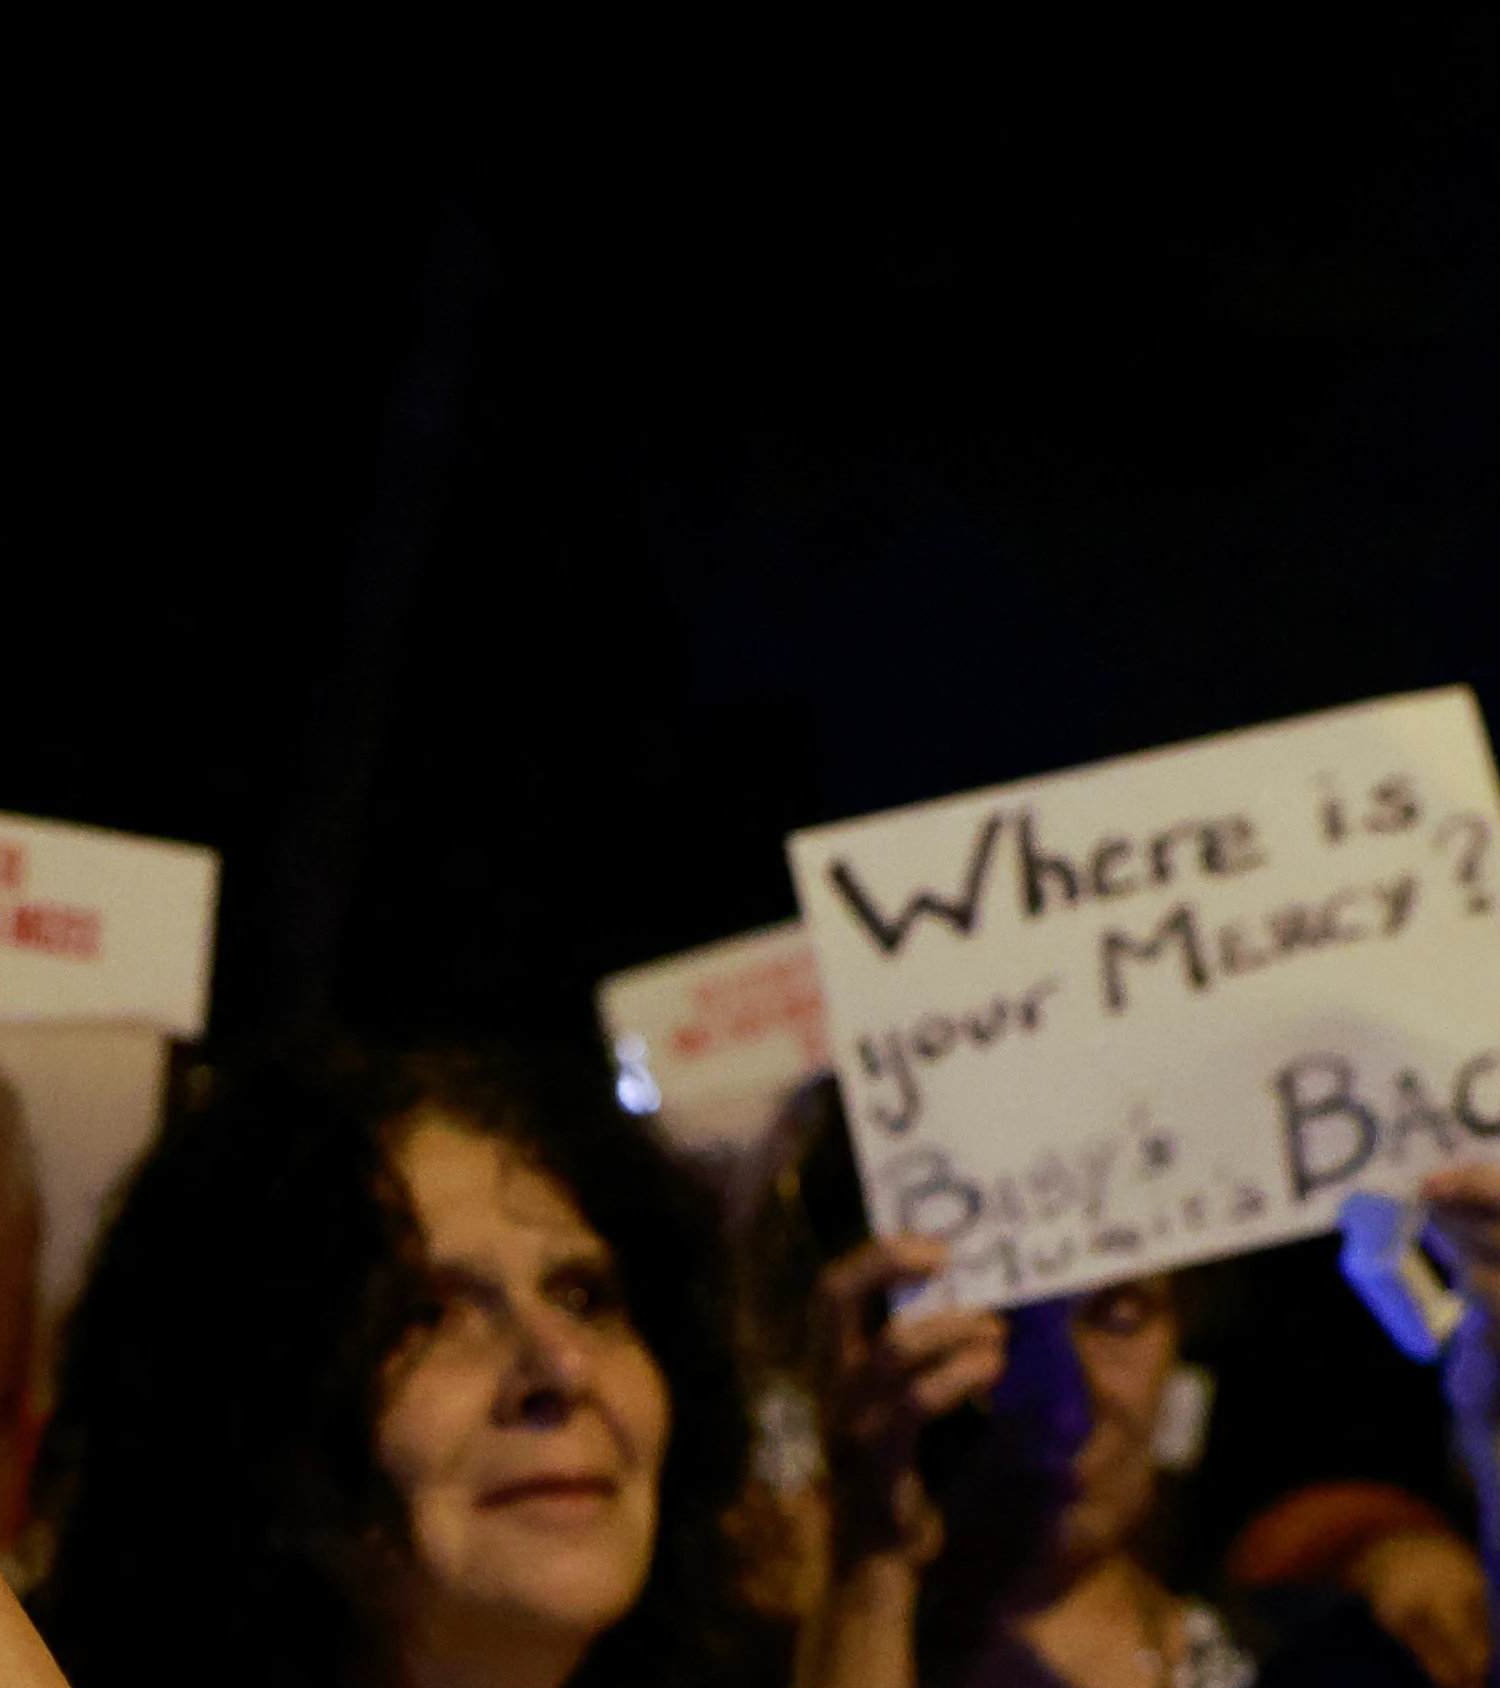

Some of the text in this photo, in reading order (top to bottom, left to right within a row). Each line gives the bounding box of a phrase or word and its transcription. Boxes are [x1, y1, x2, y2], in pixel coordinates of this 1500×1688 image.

[829, 768, 1421, 956] Where is
[857, 978, 1060, 1133] your
